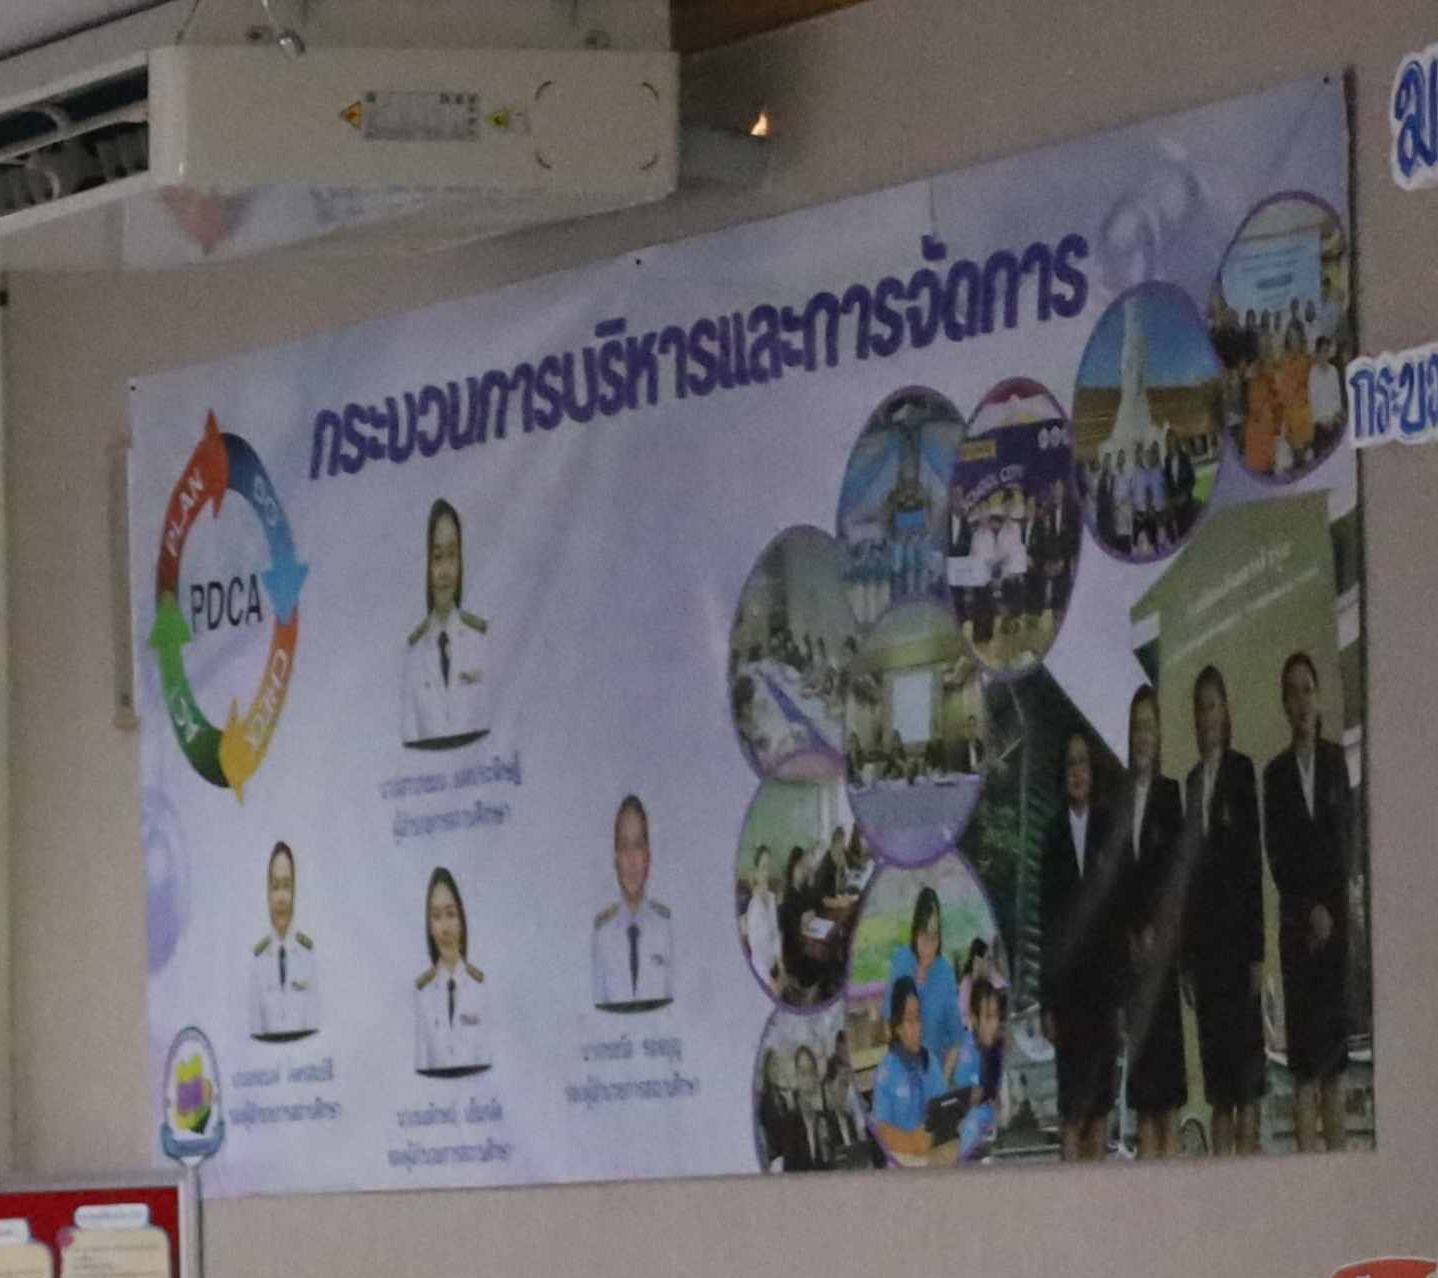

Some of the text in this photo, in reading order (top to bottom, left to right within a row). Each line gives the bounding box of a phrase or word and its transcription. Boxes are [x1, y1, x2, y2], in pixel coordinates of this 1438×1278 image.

[309, 234, 1090, 480] กระบวนการบริหารและการจัดการ
[189, 572, 264, 633] PDCA
